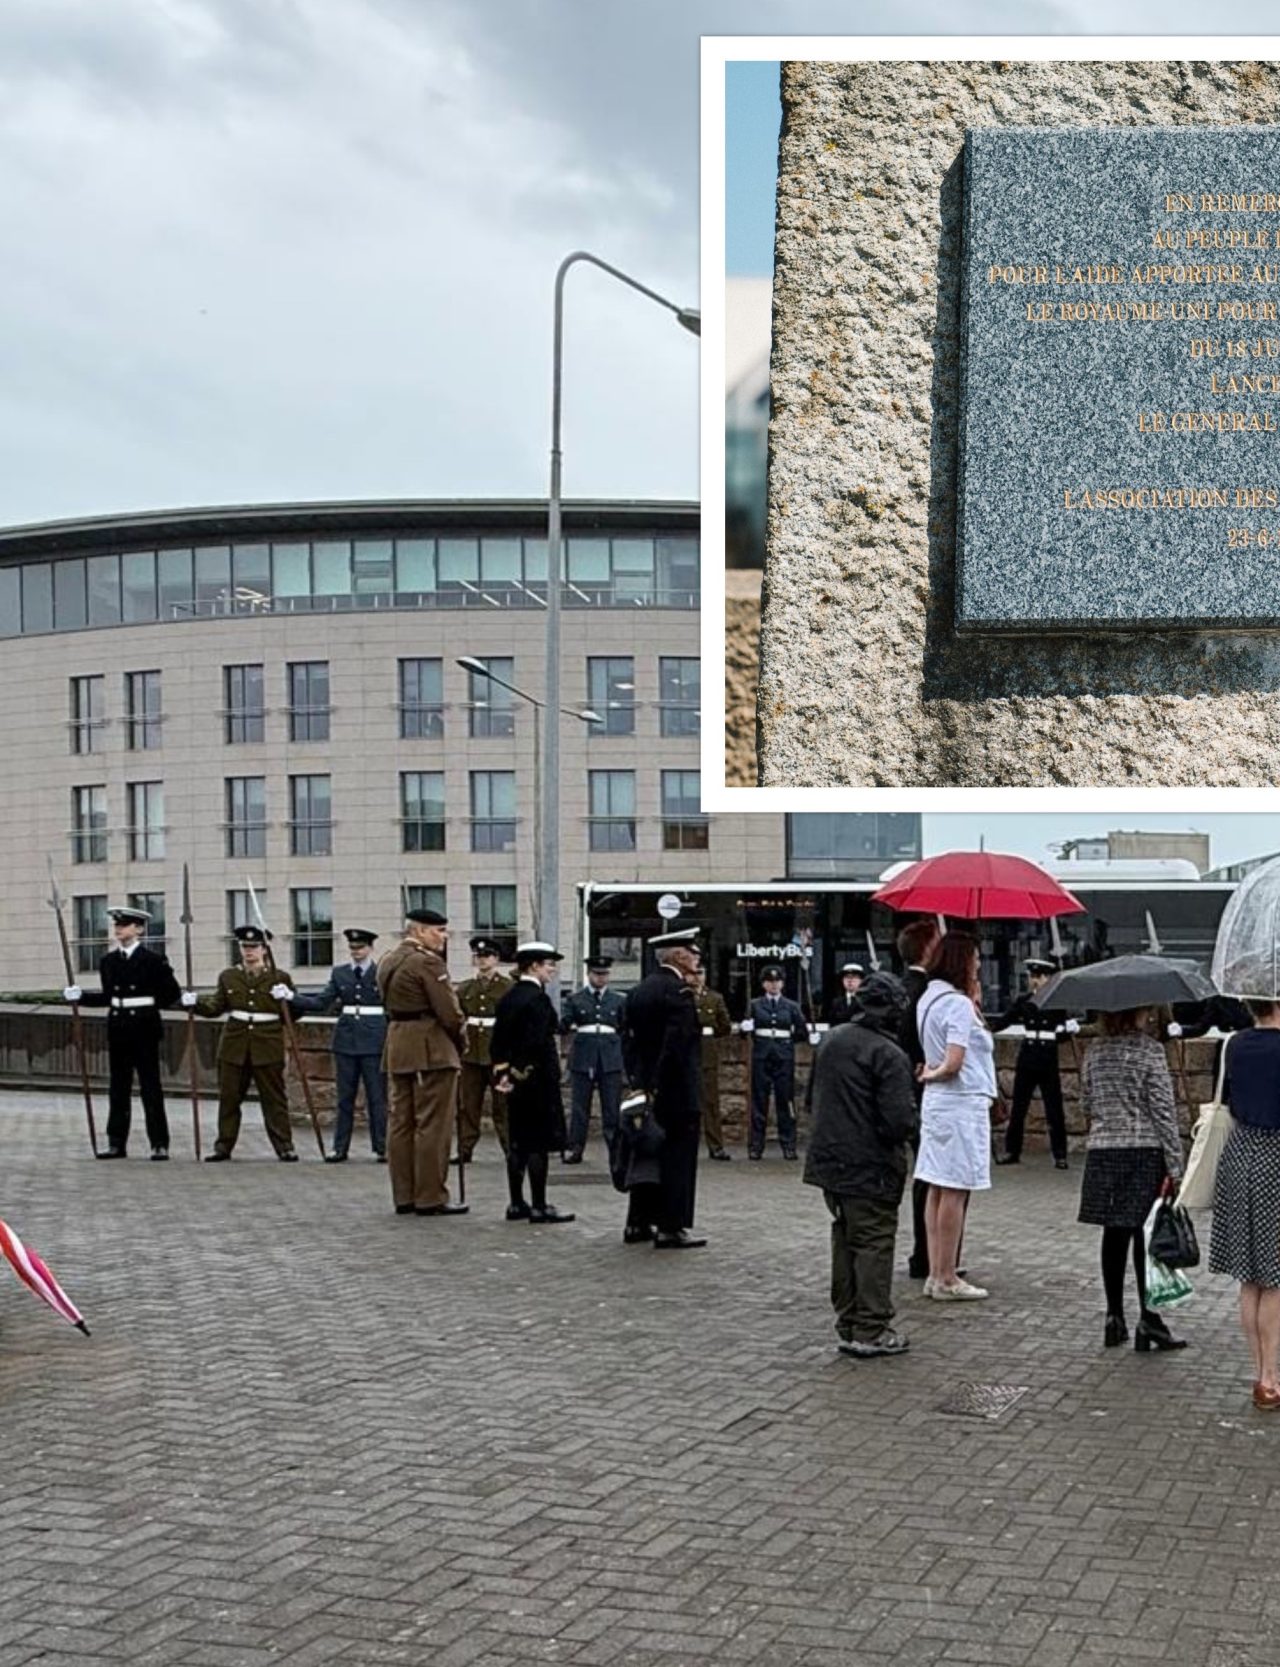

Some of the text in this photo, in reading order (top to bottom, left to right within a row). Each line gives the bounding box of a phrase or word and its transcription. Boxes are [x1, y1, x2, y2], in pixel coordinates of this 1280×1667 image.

[1165, 193, 1193, 213] EN
[1153, 230, 1180, 249] AU
[1186, 230, 1269, 249] PEUPLE
[988, 264, 1049, 284] POUR
[1055, 264, 1124, 284] L'AIDE
[1130, 264, 1244, 284] APPORTEE
[1025, 302, 1053, 322] LE
[1060, 302, 1211, 322] ROYAUME-UNI
[1217, 302, 1277, 322] POUR
[1190, 338, 1220, 359] DU
[1226, 338, 1247, 359] 18
[1138, 411, 1166, 432] LE
[1171, 411, 1277, 432] GENERAL
[1235, 488, 1278, 509] DES
